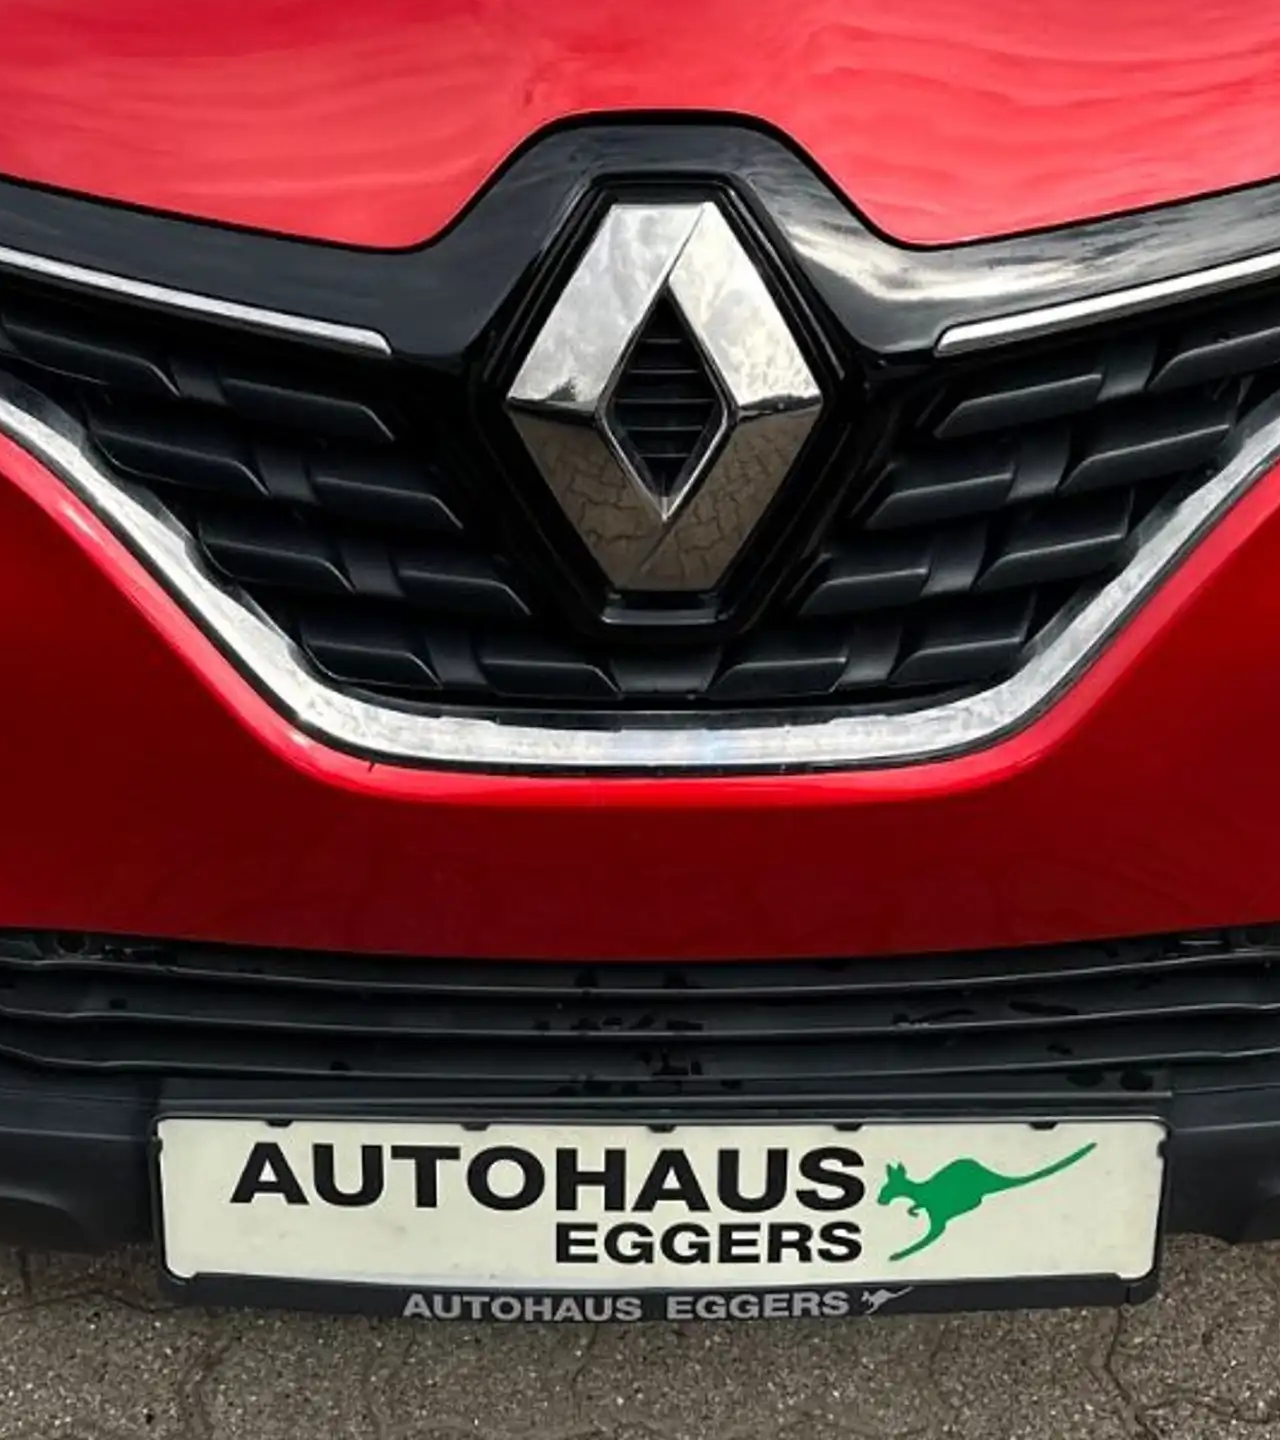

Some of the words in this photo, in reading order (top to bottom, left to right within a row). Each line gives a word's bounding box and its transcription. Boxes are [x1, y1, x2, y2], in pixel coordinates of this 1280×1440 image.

[230, 1142, 864, 1212] AUTOHAUS
[556, 1222, 861, 1264] EGGERS
[403, 1293, 642, 1322] AUTOHAUS
[667, 1290, 849, 1320] EGGERS
